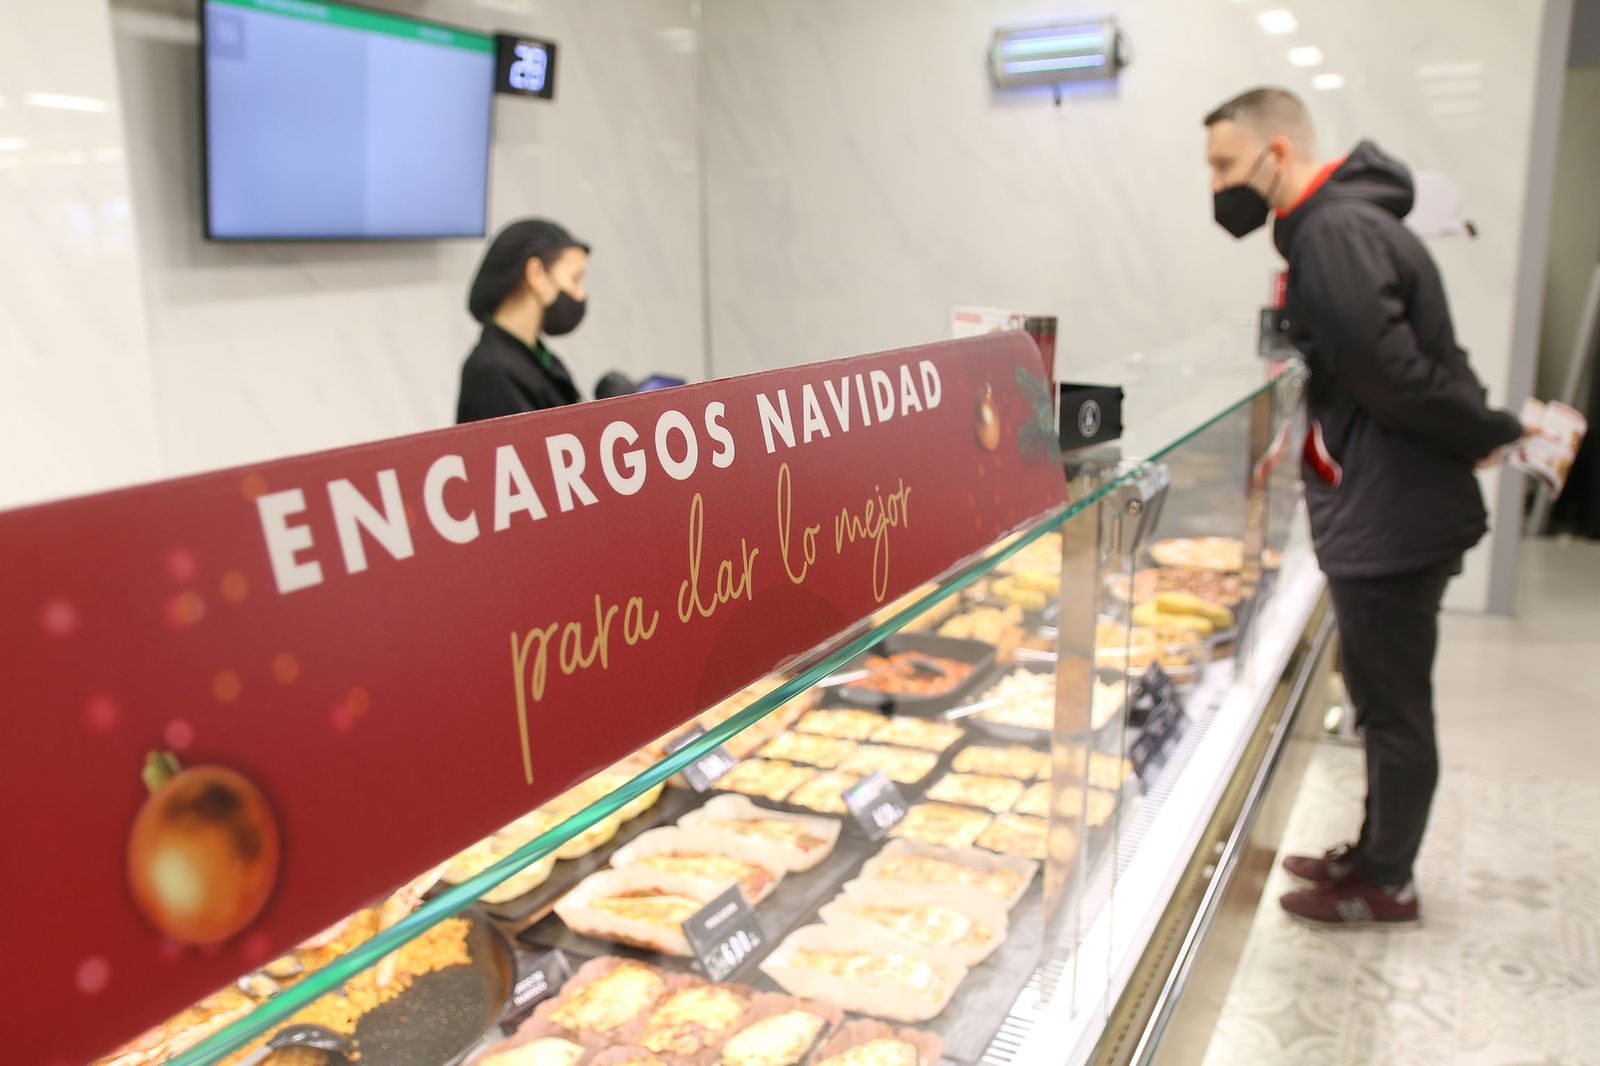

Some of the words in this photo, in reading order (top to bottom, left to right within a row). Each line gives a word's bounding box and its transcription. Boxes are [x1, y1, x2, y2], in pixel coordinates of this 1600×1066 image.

[256, 401, 736, 594] ENCARGOS
[756, 359, 943, 454] NAVIDAD
[511, 594, 660, 785] para
[677, 492, 760, 624] dar
[777, 462, 821, 585] lo
[835, 477, 912, 603] mejor
